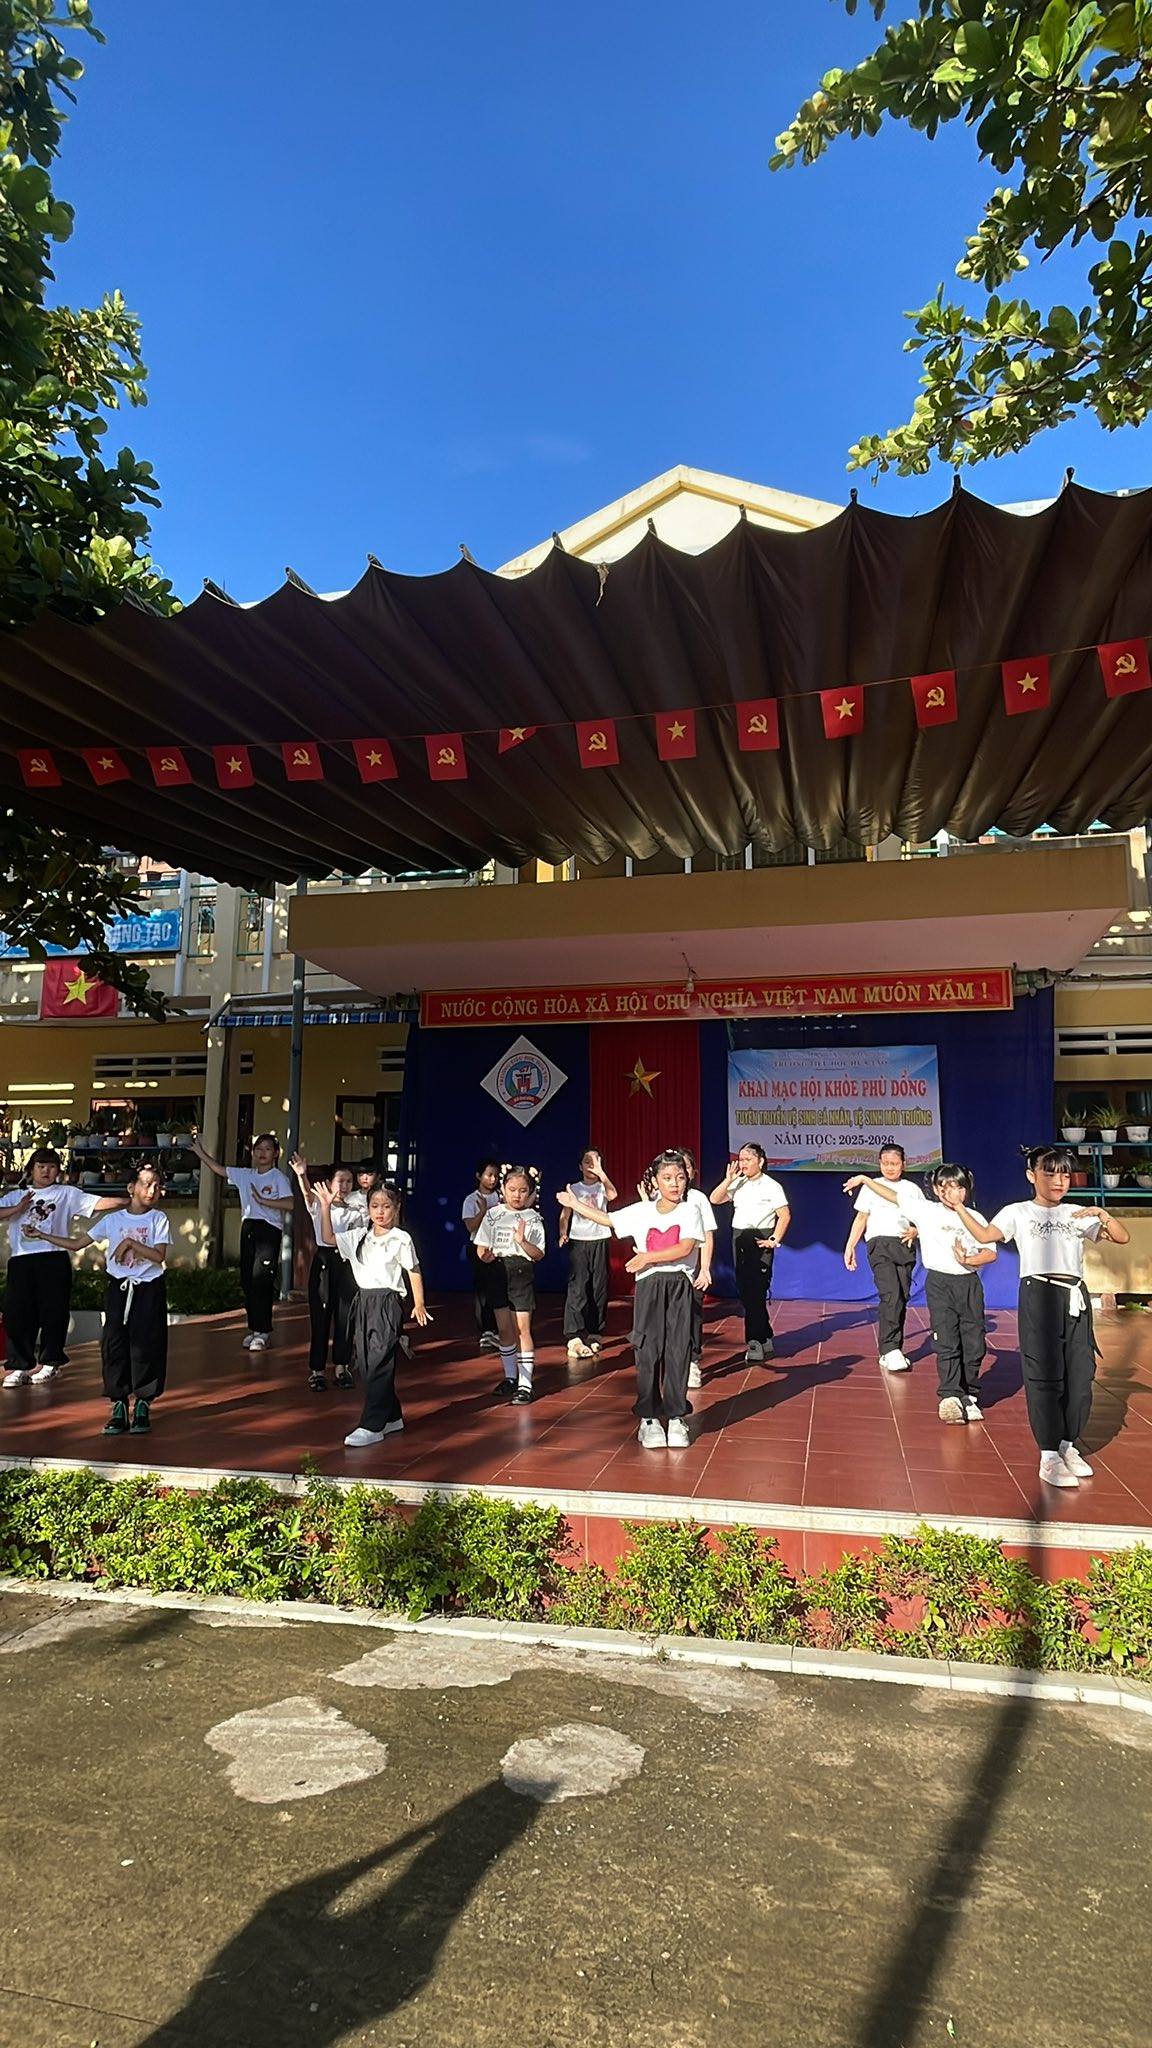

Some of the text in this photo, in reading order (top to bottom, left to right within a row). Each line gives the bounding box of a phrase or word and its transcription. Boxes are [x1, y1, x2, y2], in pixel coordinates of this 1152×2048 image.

[145, 922, 172, 946] TẠO
[441, 998, 486, 1018] NƯỚC
[491, 996, 538, 1019] CỘNG
[543, 994, 580, 1014] HÒA
[585, 992, 610, 1013] XÃ
[615, 991, 648, 1015] HỘI
[697, 988, 757, 1009] NGHĨA
[762, 985, 808, 1009] VIỆT
[813, 988, 857, 1006] NAM
[863, 981, 921, 1004] MUÔN
[928, 979, 974, 1001] NĂM
[982, 982, 988, 999] !
[738, 1070, 927, 1102] KHAI MẠC HỘI KHỎE PHÙ ĐỔNG
[735, 1107, 759, 1125] TUYÊN
[786, 1106, 798, 1129] VỆ
[799, 1109, 818, 1125] SINH
[818, 1106, 829, 1125] CÁ
[854, 1106, 864, 1129] VỆ
[865, 1109, 884, 1125] SINH
[884, 1106, 900, 1125] MÔI
[901, 1106, 933, 1126] TRƯỜNG
[774, 1131, 895, 1148] NĂM HỌC: 2025-2026
